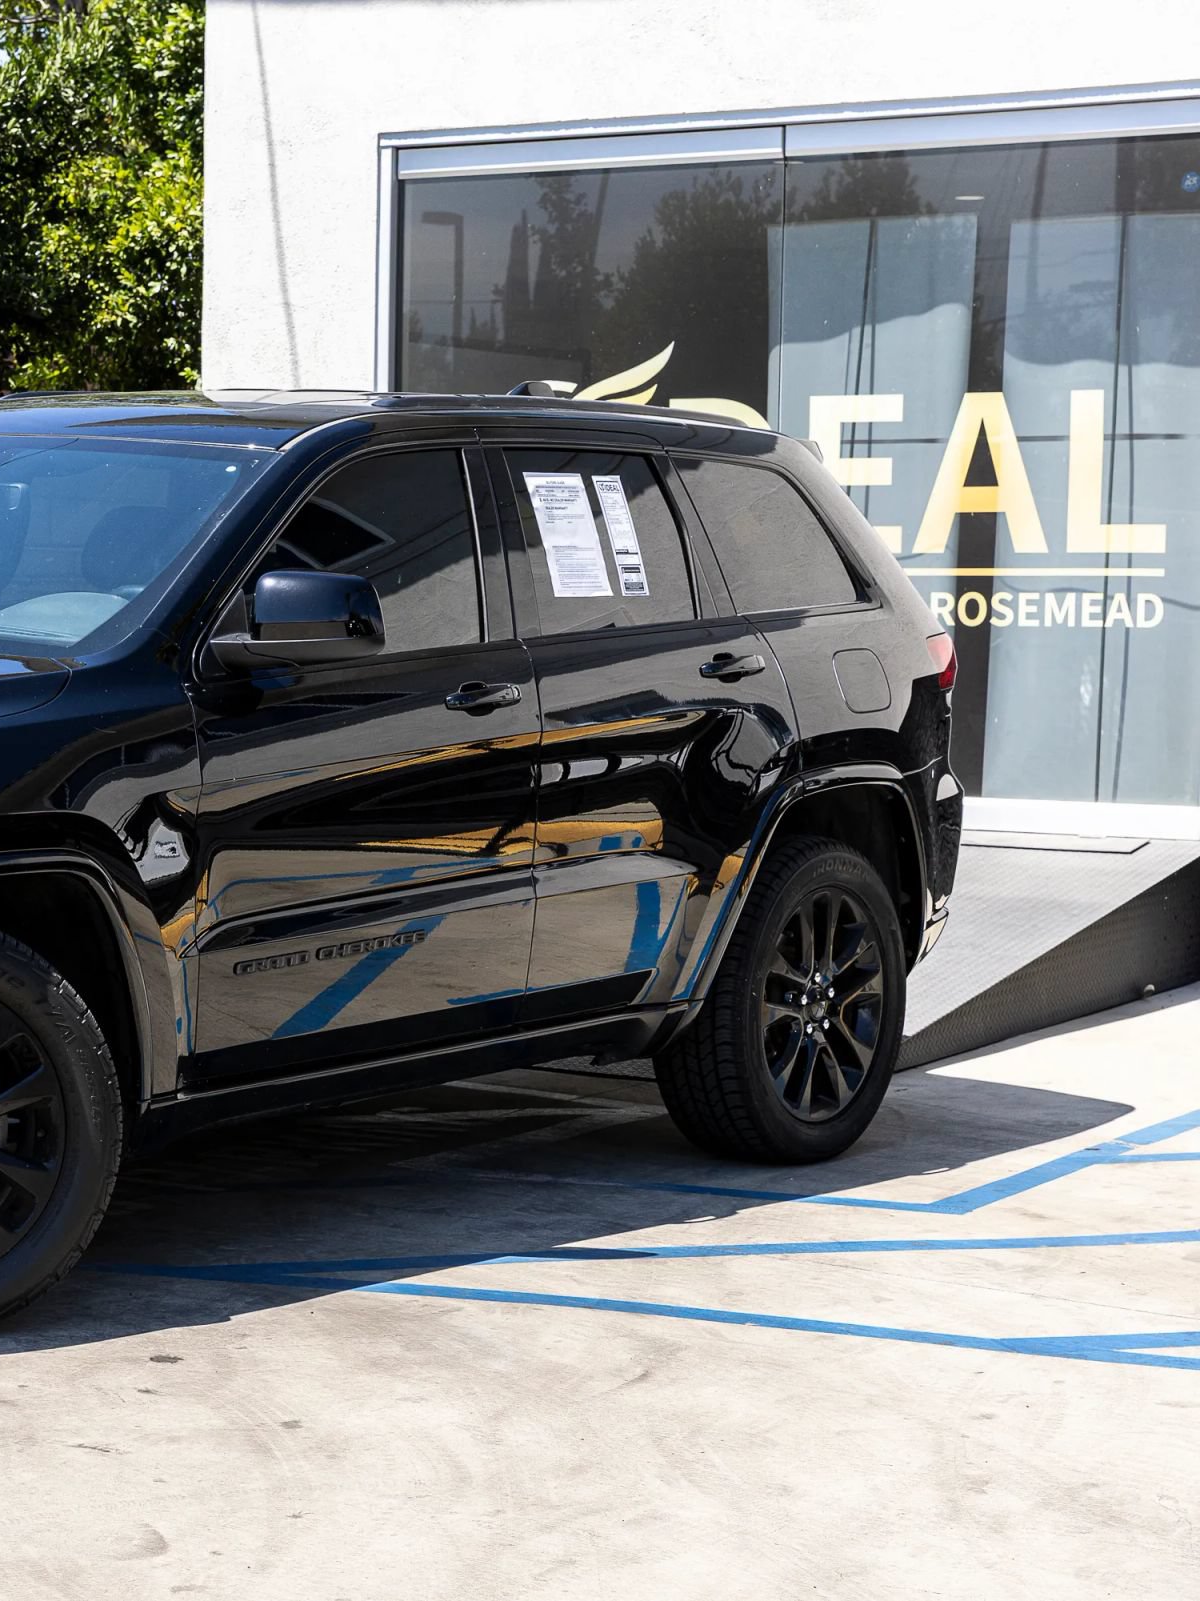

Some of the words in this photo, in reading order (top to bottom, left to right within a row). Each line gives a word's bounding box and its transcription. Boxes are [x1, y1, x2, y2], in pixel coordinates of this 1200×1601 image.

[929, 591, 1165, 629] ROSEMEAD
[233, 950, 310, 976] GRAND
[316, 929, 425, 961] CHEROKEE
